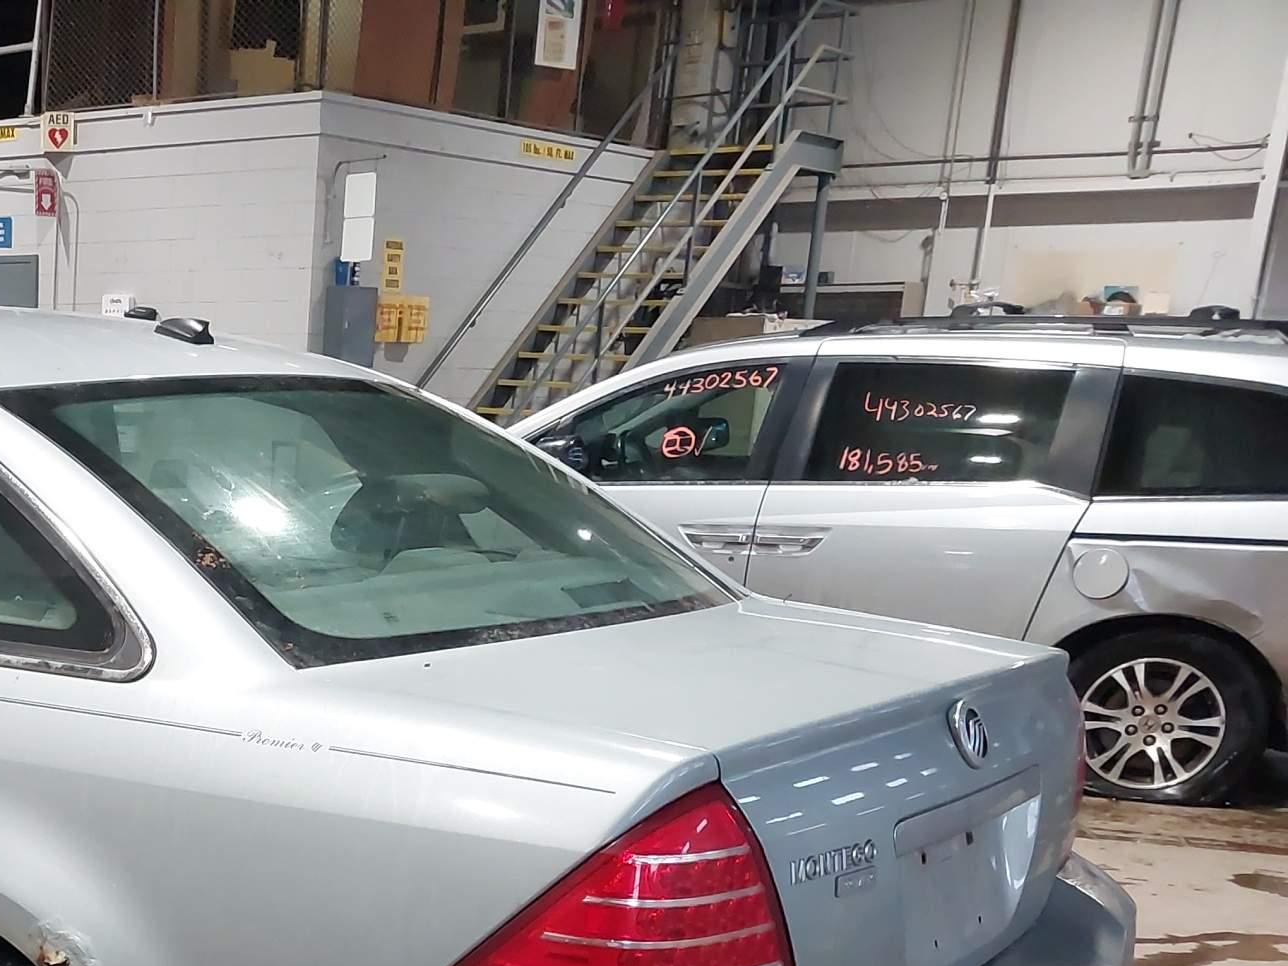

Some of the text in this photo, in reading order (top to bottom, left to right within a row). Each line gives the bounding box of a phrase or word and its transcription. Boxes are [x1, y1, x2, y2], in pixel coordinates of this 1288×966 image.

[48, 113, 69, 125] AED
[0, 127, 16, 139] MAX
[664, 367, 778, 401] 44302567
[863, 391, 977, 422] 44302567
